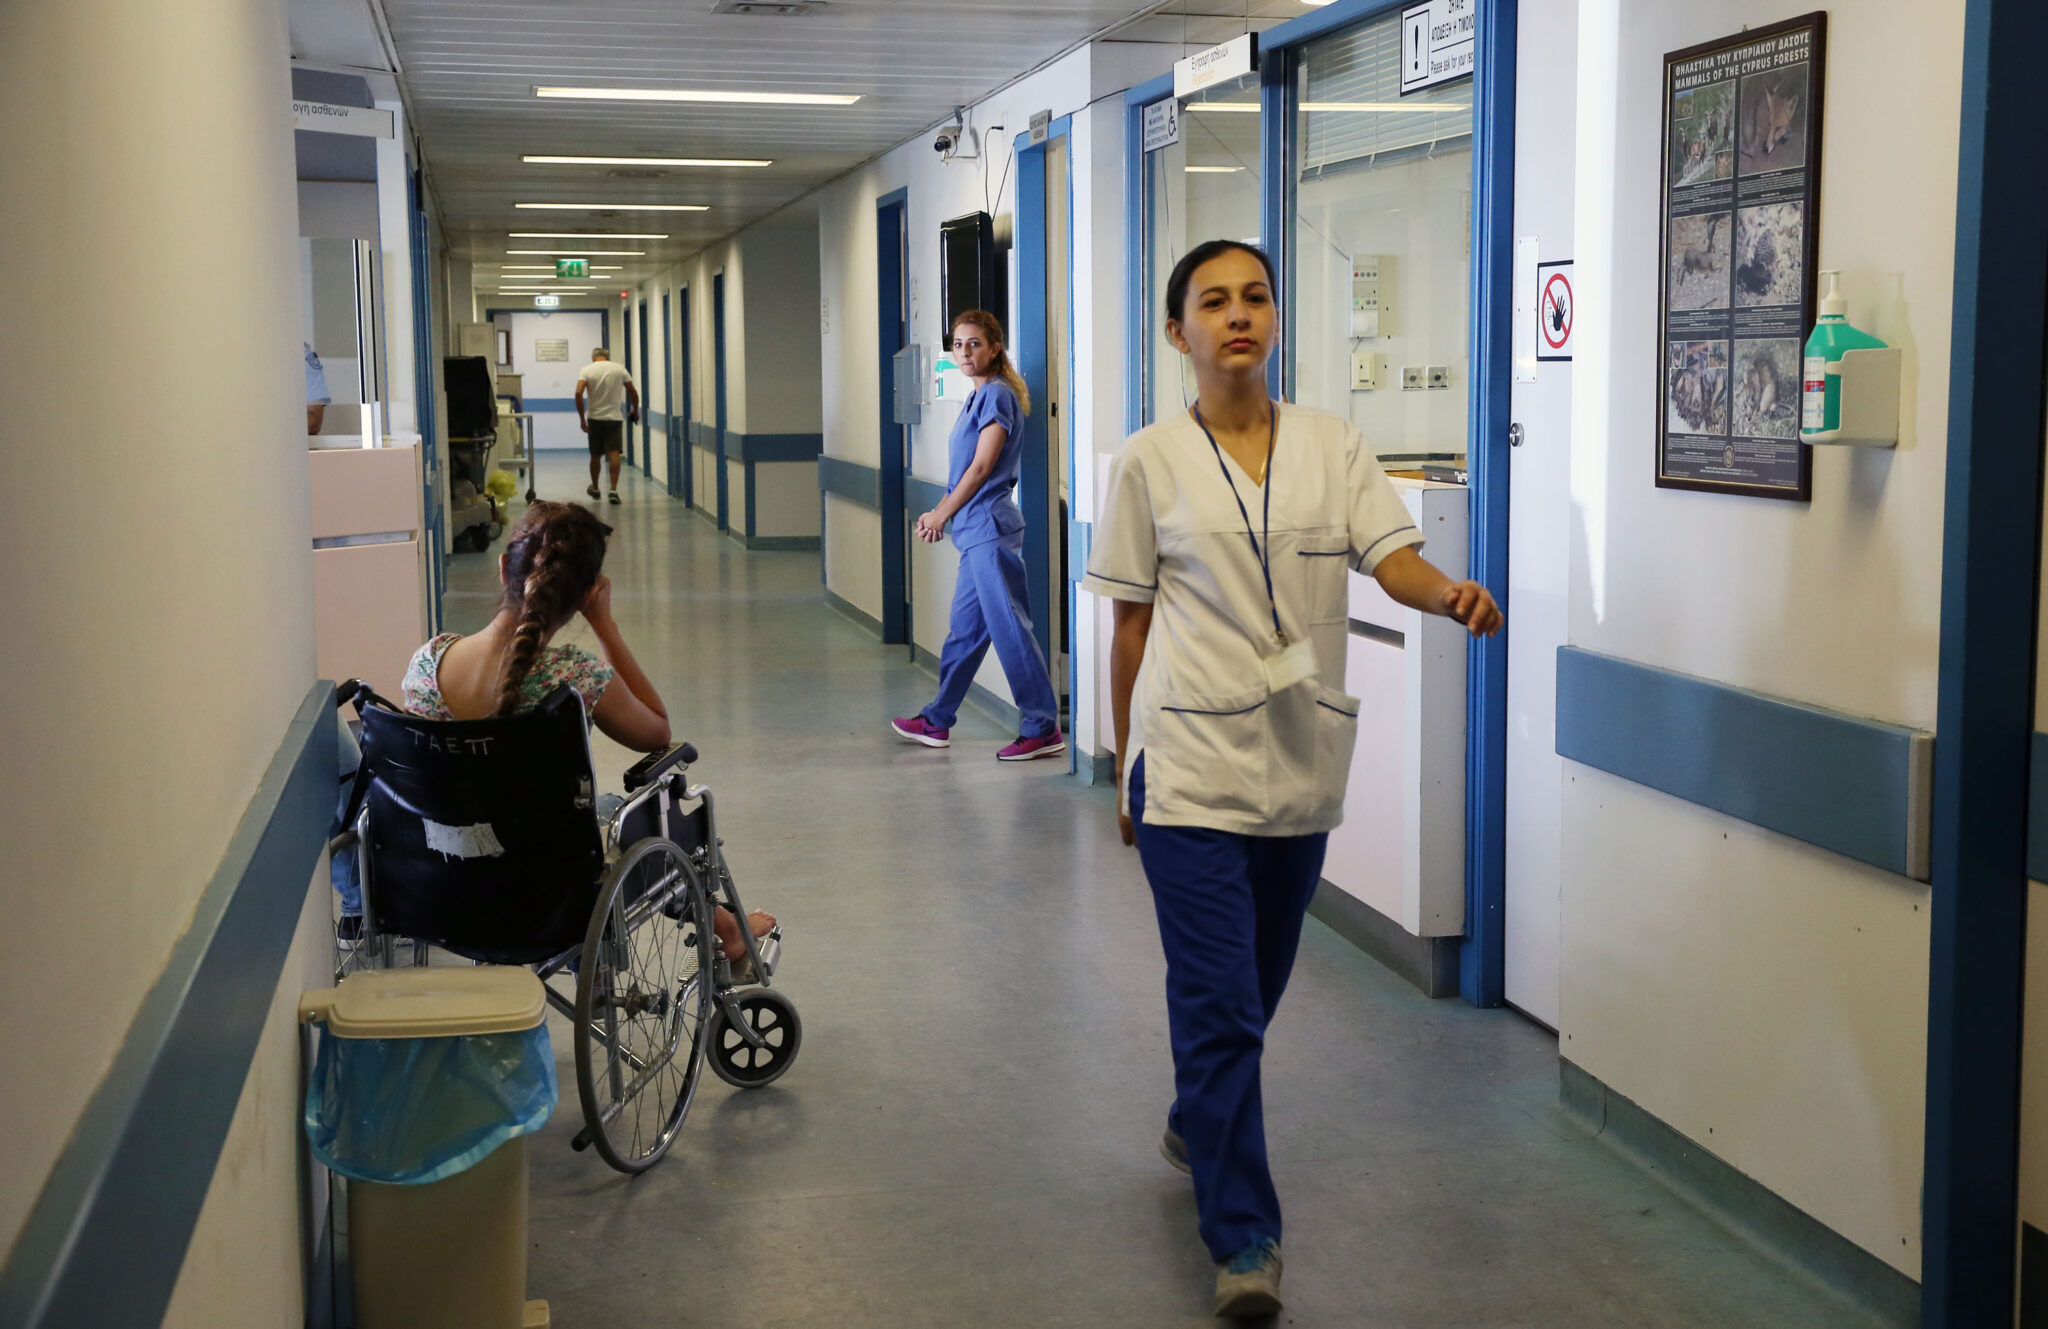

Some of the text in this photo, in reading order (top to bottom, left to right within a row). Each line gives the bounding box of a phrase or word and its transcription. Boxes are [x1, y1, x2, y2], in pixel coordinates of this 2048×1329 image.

[1675, 32, 1809, 76] ΘΗΛΑΣΤΙΚΑ ΤΟΥ ΚΥΠΡΙΑΚΟΥ ΔΑΣΟΥΣ
[1675, 47, 1809, 89] MAMMALS OF THE CYPRUS FORESTS
[312, 104, 349, 117] ασθενών
